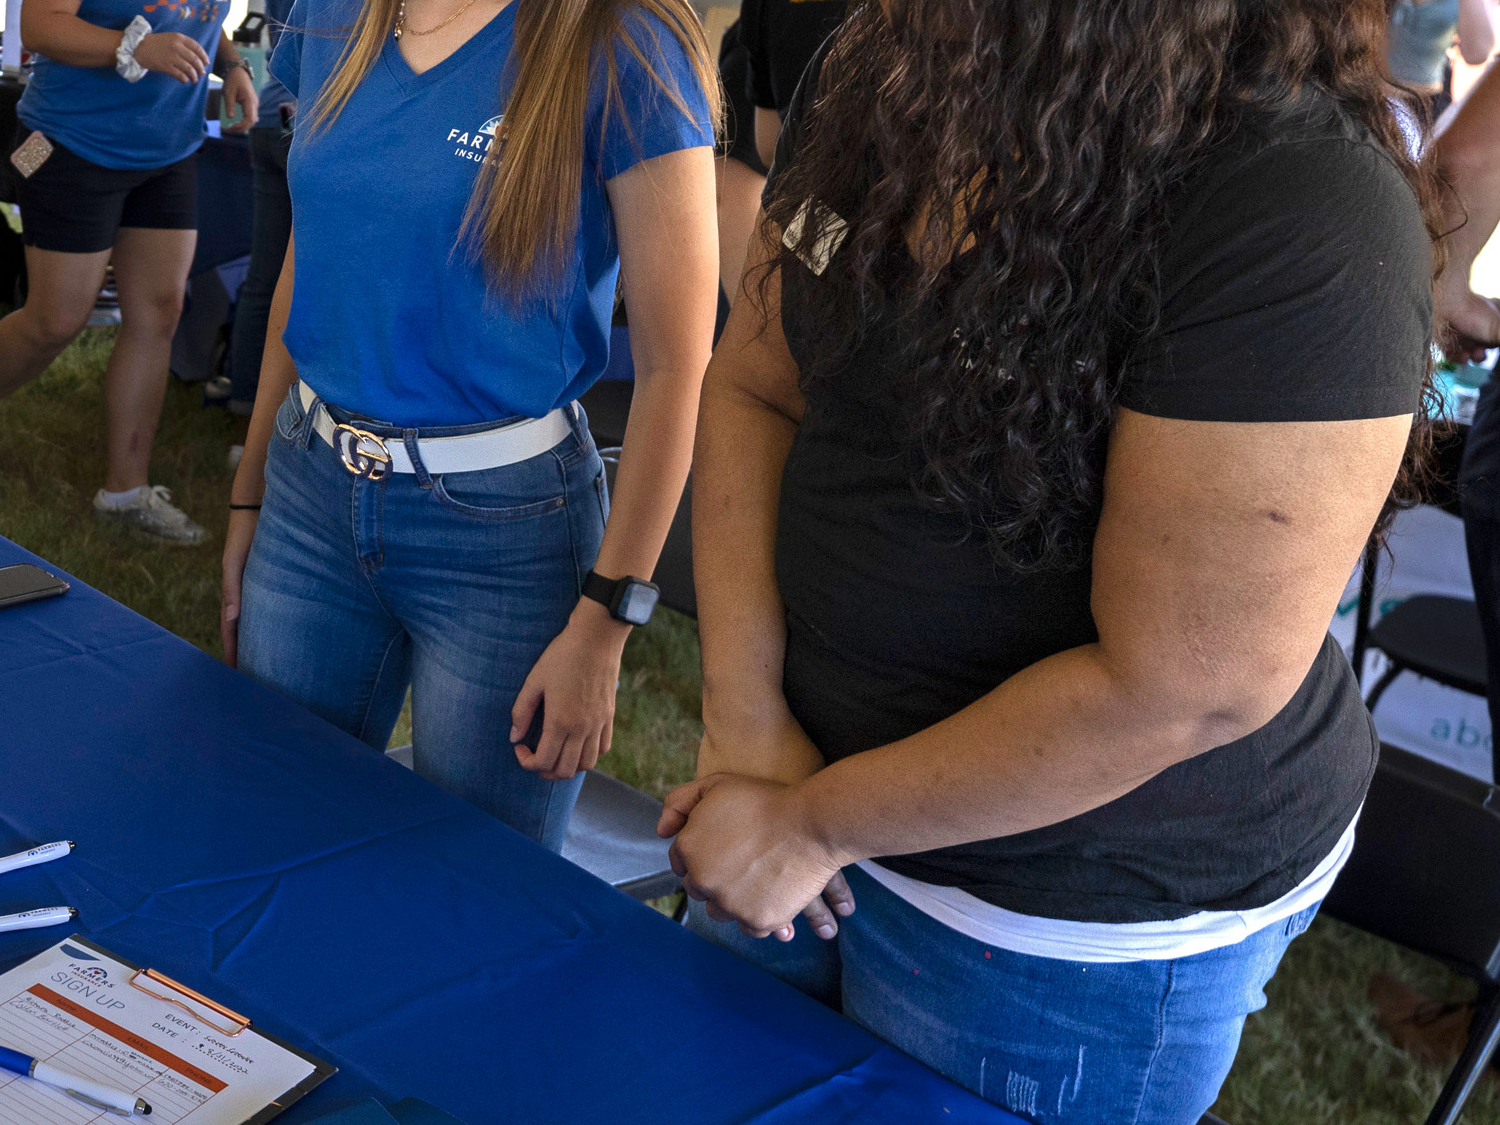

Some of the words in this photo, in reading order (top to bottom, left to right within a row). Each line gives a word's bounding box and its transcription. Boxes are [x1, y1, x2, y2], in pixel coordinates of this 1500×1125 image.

[68, 962, 115, 989] FARMERS
[70, 970, 102, 988] INSURANCE
[50, 971, 98, 998] SIGN
[95, 994, 126, 1010] UP
[152, 1022, 179, 1039] DATE
